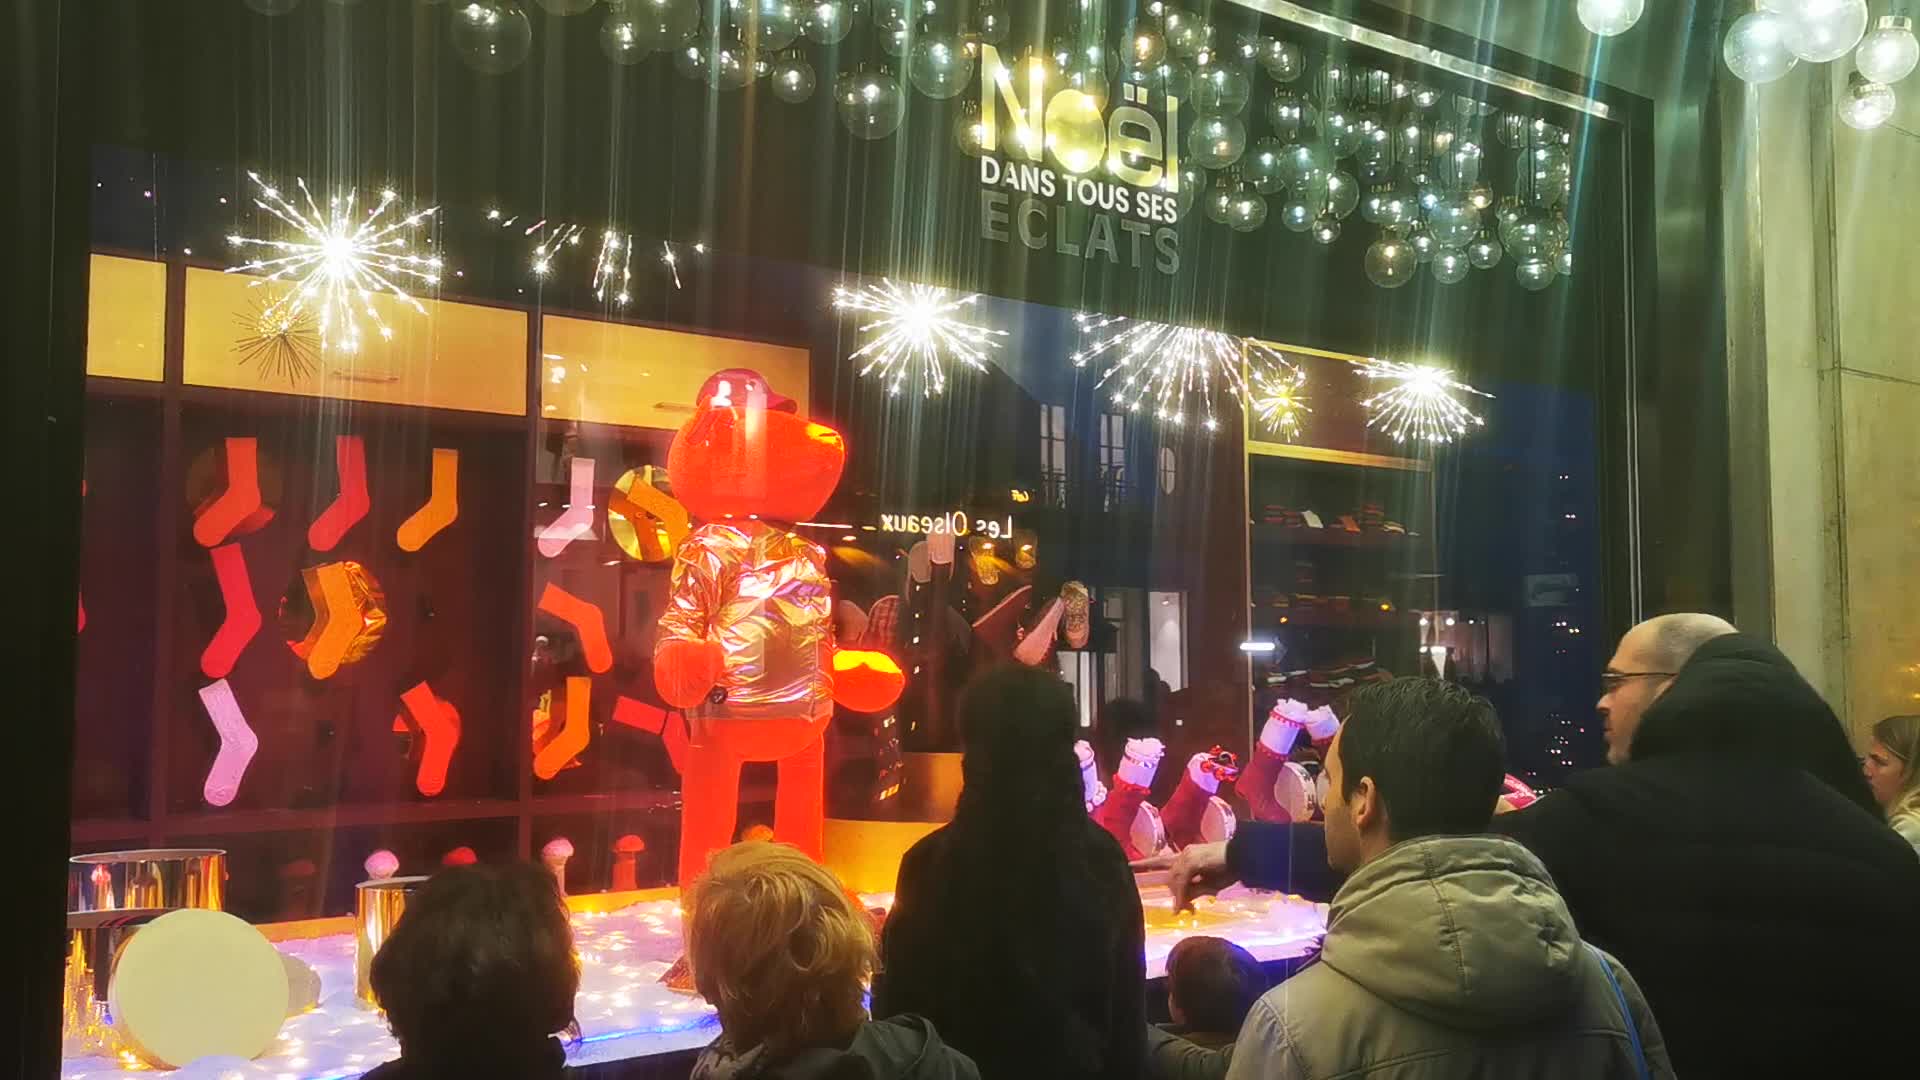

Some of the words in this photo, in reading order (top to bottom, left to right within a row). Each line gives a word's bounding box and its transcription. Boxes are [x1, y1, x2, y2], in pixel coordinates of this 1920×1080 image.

[981, 156, 1056, 197] DANS
[1062, 174, 1130, 213] TOUS
[1137, 191, 1177, 223] SES
[981, 188, 1180, 275] ECLATS
